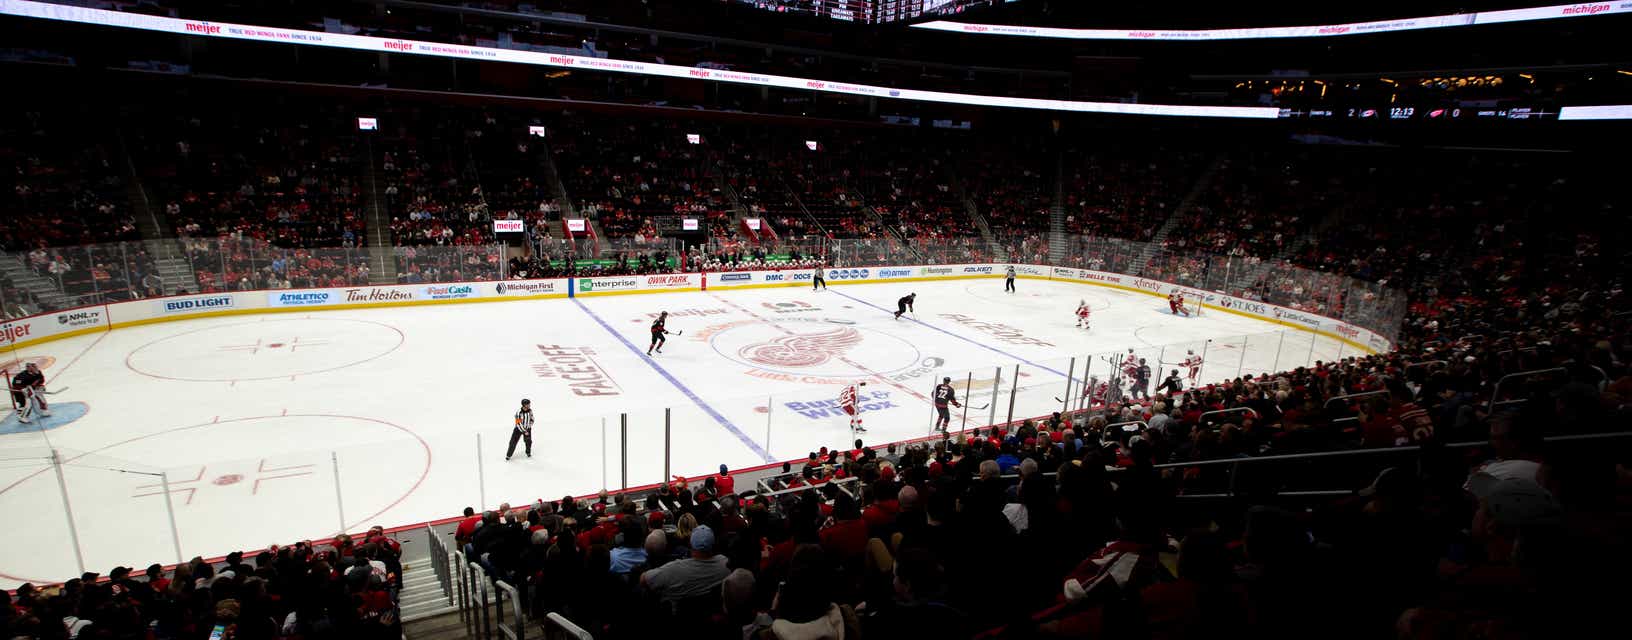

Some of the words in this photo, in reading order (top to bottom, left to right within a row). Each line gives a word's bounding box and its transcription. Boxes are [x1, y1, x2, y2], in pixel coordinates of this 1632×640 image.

[1562, 2, 1610, 15] michigan
[186, 21, 221, 34] meijer
[384, 40, 412, 52] meijer
[550, 56, 574, 66] meijer
[689, 68, 710, 78] meijer
[807, 80, 825, 89] meijer
[1390, 107, 1415, 116] 12:13
[1452, 108, 1460, 117] 0
[496, 220, 522, 231] meijer
[647, 277, 667, 285] QWIK
[668, 275, 689, 283] PARK
[507, 283, 538, 291] Michigan
[1134, 279, 1162, 292] xfinity
[346, 289, 367, 302] Tim
[369, 288, 413, 302] Hortons
[167, 300, 194, 310] BUD
[195, 298, 231, 308] LIGHT
